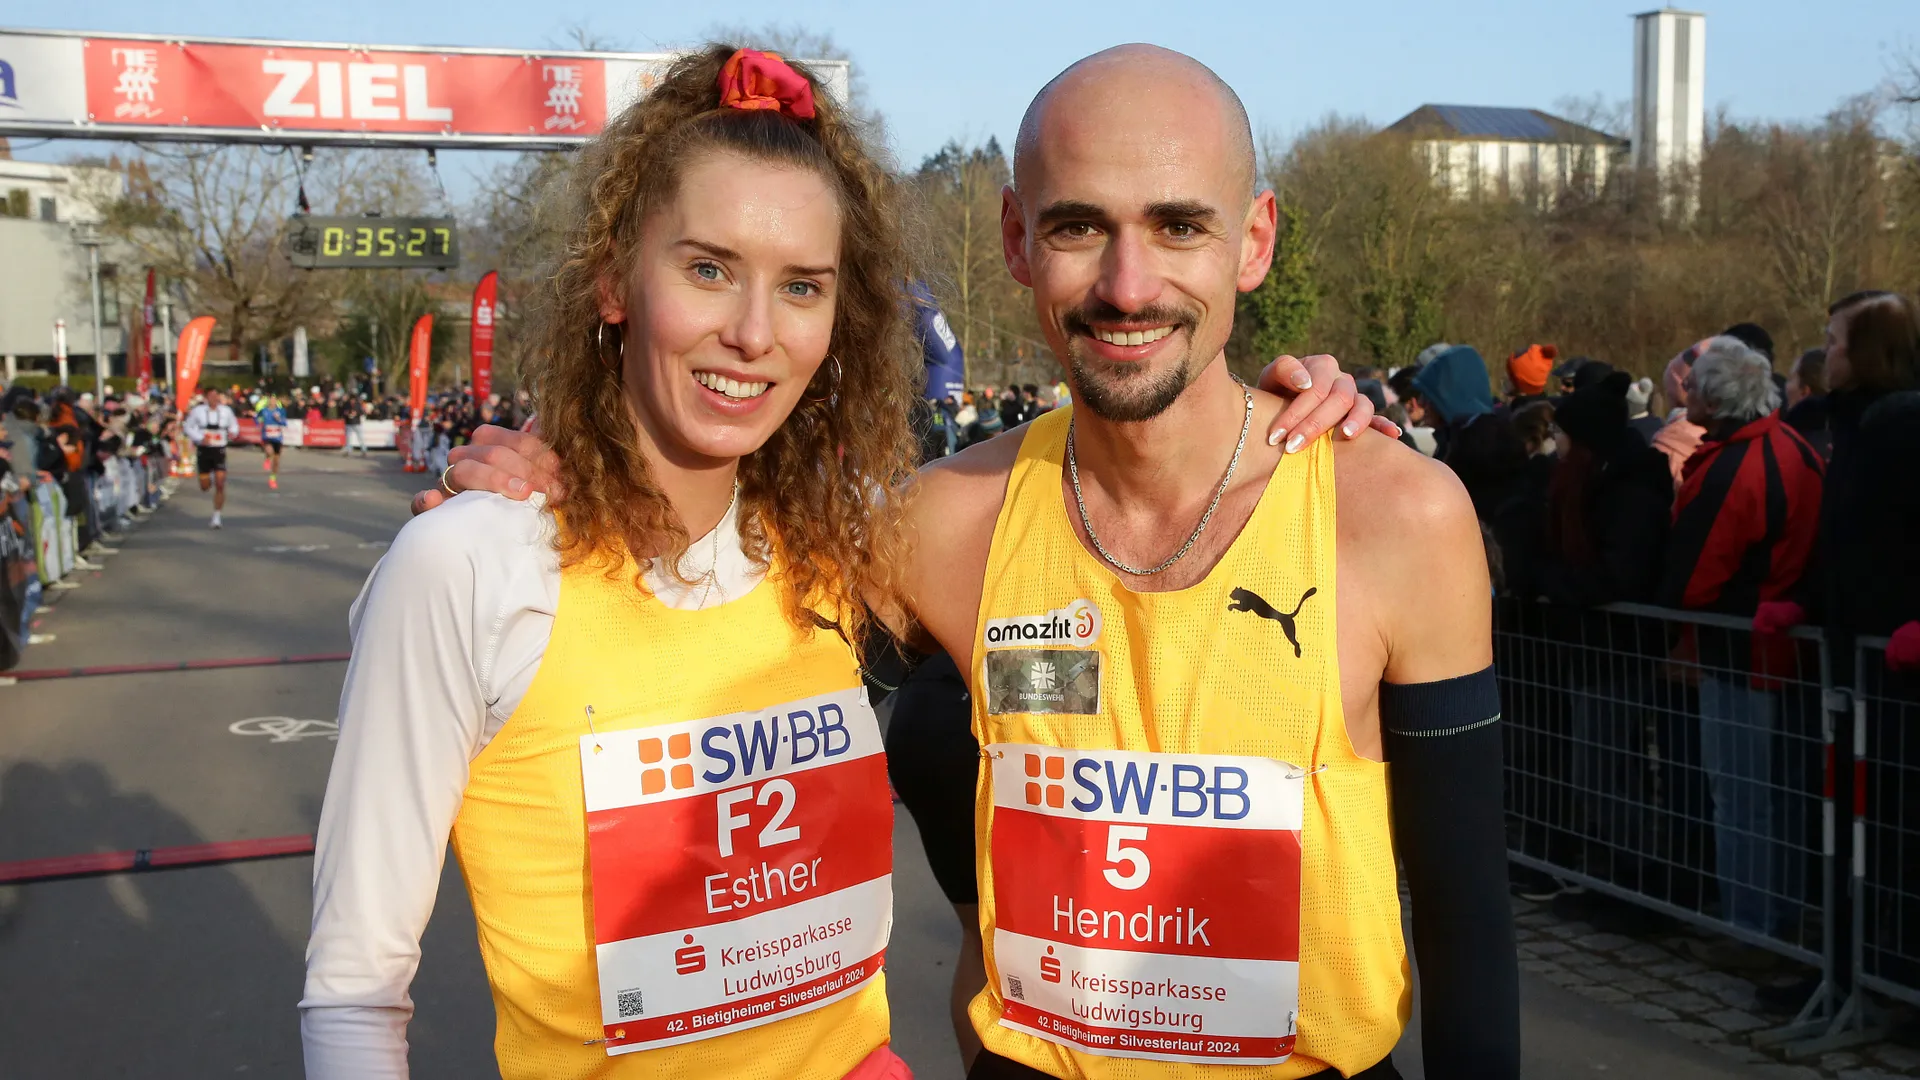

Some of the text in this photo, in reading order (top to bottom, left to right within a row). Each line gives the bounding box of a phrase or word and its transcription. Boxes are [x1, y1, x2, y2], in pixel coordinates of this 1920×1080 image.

[263, 59, 452, 122] ZIEL
[323, 226, 450, 257] 0:35:27
[988, 616, 1071, 642] amazfit
[1019, 693, 1064, 701] BUNDESWEHR
[716, 778, 801, 858] F2
[1102, 824, 1151, 891] 5
[704, 856, 823, 915] Esther
[720, 916, 852, 967] Kreissparkasse
[1053, 895, 1211, 946] Hendrik
[723, 947, 842, 997] Ludwigsburg
[1071, 970, 1227, 1002] Kreissparkasse
[666, 966, 865, 1033] 42. Bietigheimer Silvesterlauf 2024
[1071, 1002, 1204, 1032] Ludwigsburg
[1037, 1015, 1240, 1054] 42. Bietigheimer Silvesterlauf 2024
